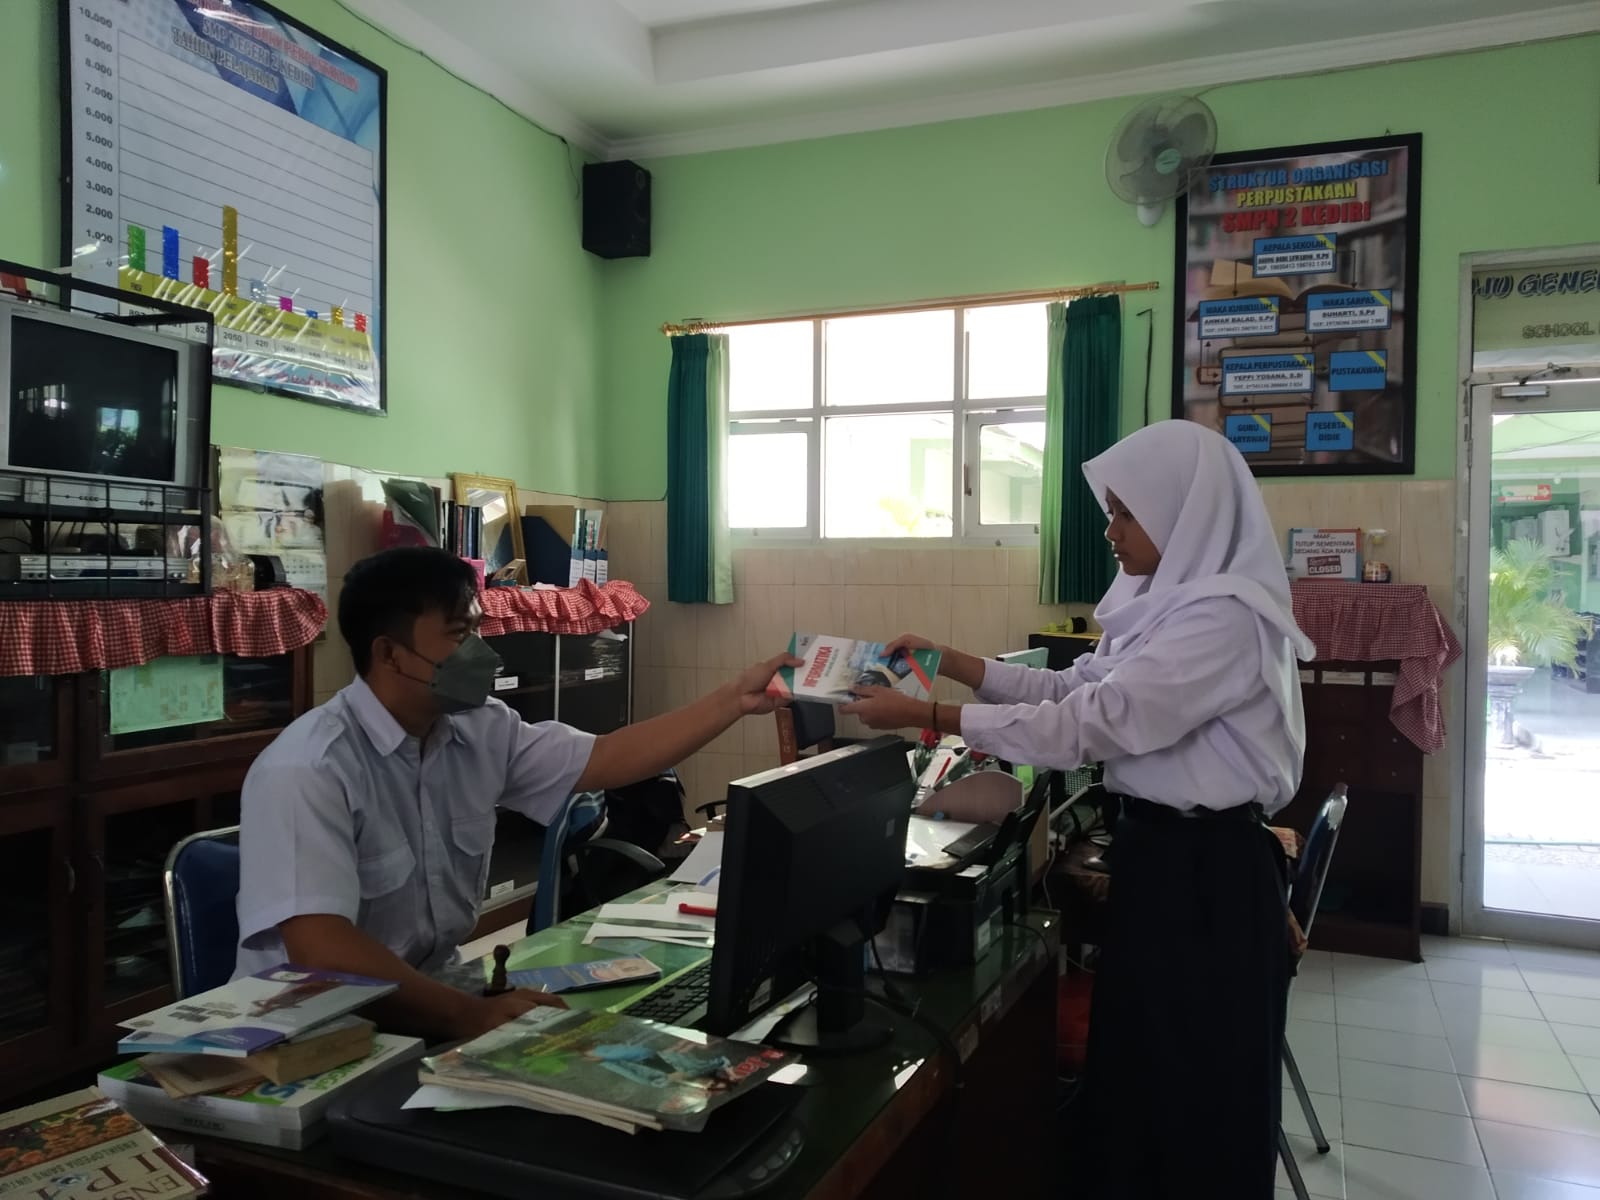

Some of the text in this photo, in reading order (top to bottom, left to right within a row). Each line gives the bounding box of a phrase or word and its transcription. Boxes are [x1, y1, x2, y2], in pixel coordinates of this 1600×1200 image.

[79, 6, 113, 29] 10.000
[85, 33, 112, 53] 9.000
[172, 26, 280, 93] TAHUN PELAJARAN
[202, 17, 229, 43] SMP
[229, 30, 271, 66] NEGERI
[270, 51, 280, 70] 2
[280, 56, 316, 91] KEDIRI
[85, 57, 112, 77] 8.000
[85, 82, 113, 101] 7.000
[85, 106, 113, 125] 6.000
[85, 131, 113, 149] 5.000
[85, 156, 113, 173] 4.000
[1209, 160, 1389, 193] STRUKTUR ORGANISASI
[85, 180, 113, 197] 3.000
[1237, 182, 1357, 208] PERPUSTAKAAN
[85, 203, 113, 220] 2.000
[1223, 201, 1372, 233] SMPN 2 KEDIRI
[85, 228, 113, 244] 1.000
[1293, 240, 1327, 250] SEKOLAH
[1518, 268, 1600, 298] GENE
[1522, 321, 1596, 340] SCHOOL
[1225, 359, 1312, 370] KEPALA PERPUSTAKAAN
[1331, 366, 1386, 377] PUSTAKAWAN
[1313, 421, 1347, 430] PESERTA
[1308, 565, 1341, 574] CLOSED
[66, 1139, 139, 1170] ENSIKLOPEDIA
[0, 1176, 33, 1194] UNTU
